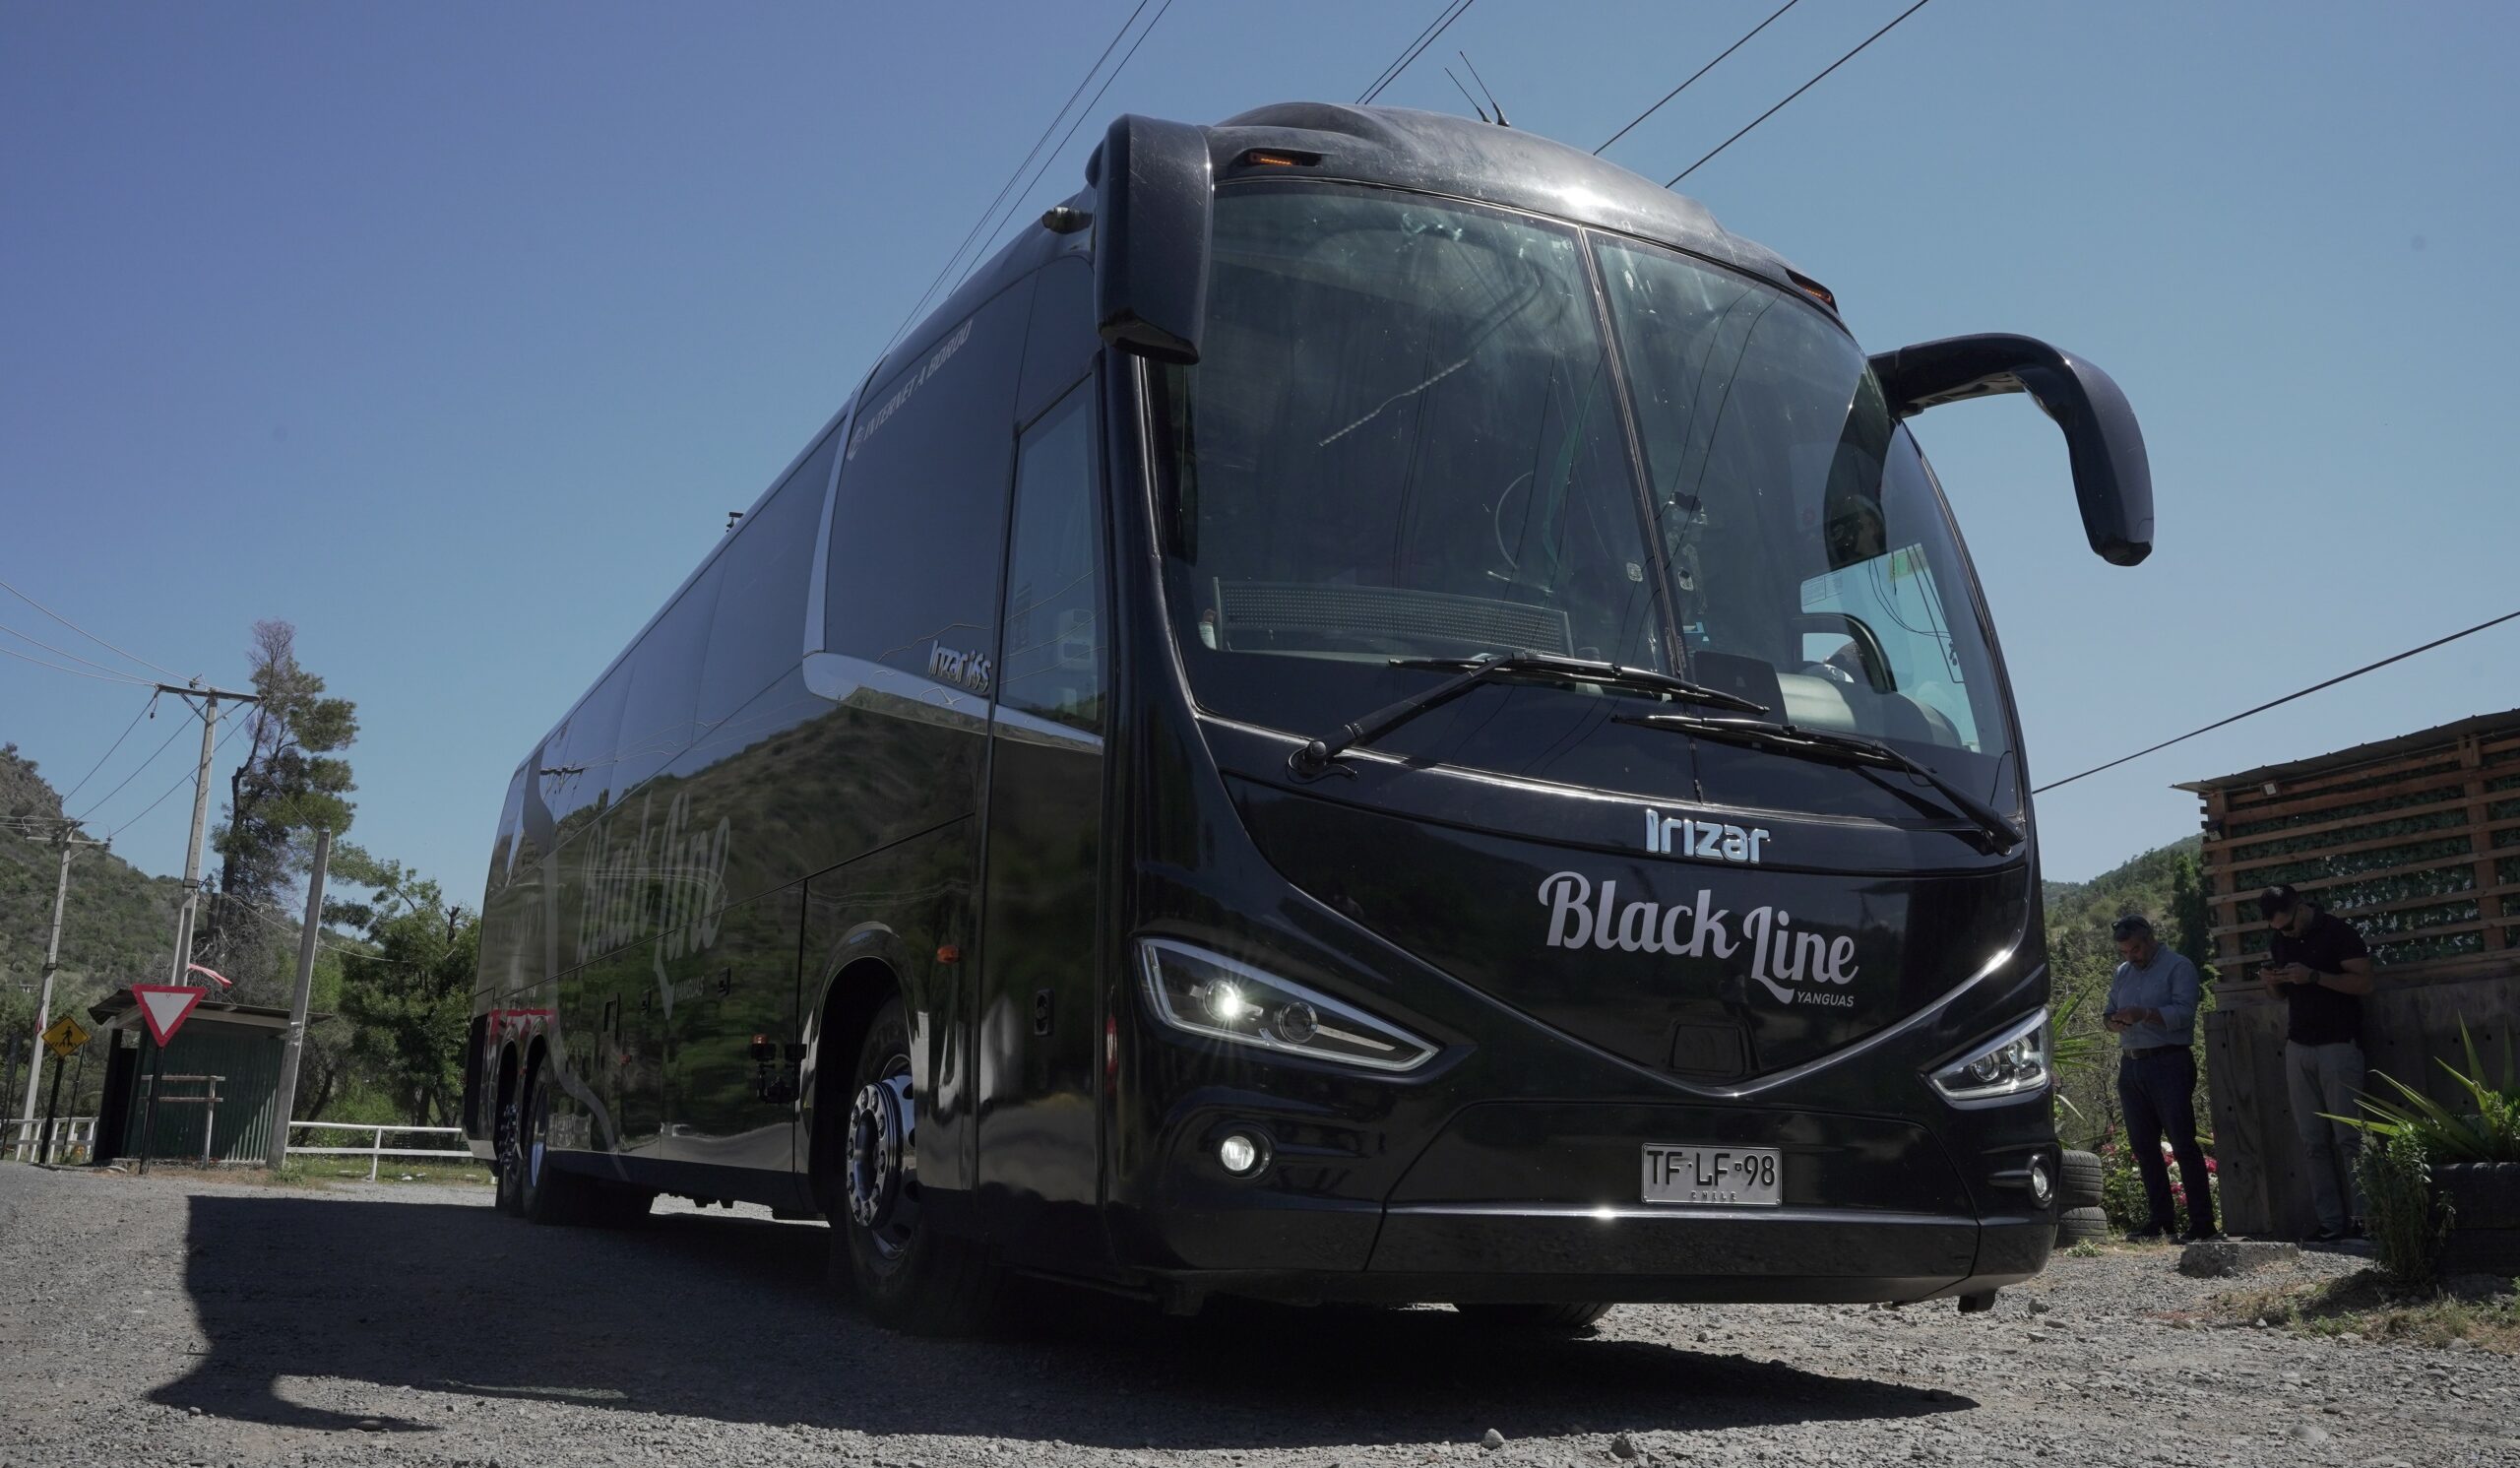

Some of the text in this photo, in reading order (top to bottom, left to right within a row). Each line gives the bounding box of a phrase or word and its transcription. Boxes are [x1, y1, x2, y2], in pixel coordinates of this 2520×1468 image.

[1645, 808, 1770, 863] Irizar
[576, 790, 655, 980] Black
[1538, 871, 1858, 1004] Black Line
[1796, 990, 1855, 1007] YANGUAS
[1690, 1190, 1736, 1201] CHILE
